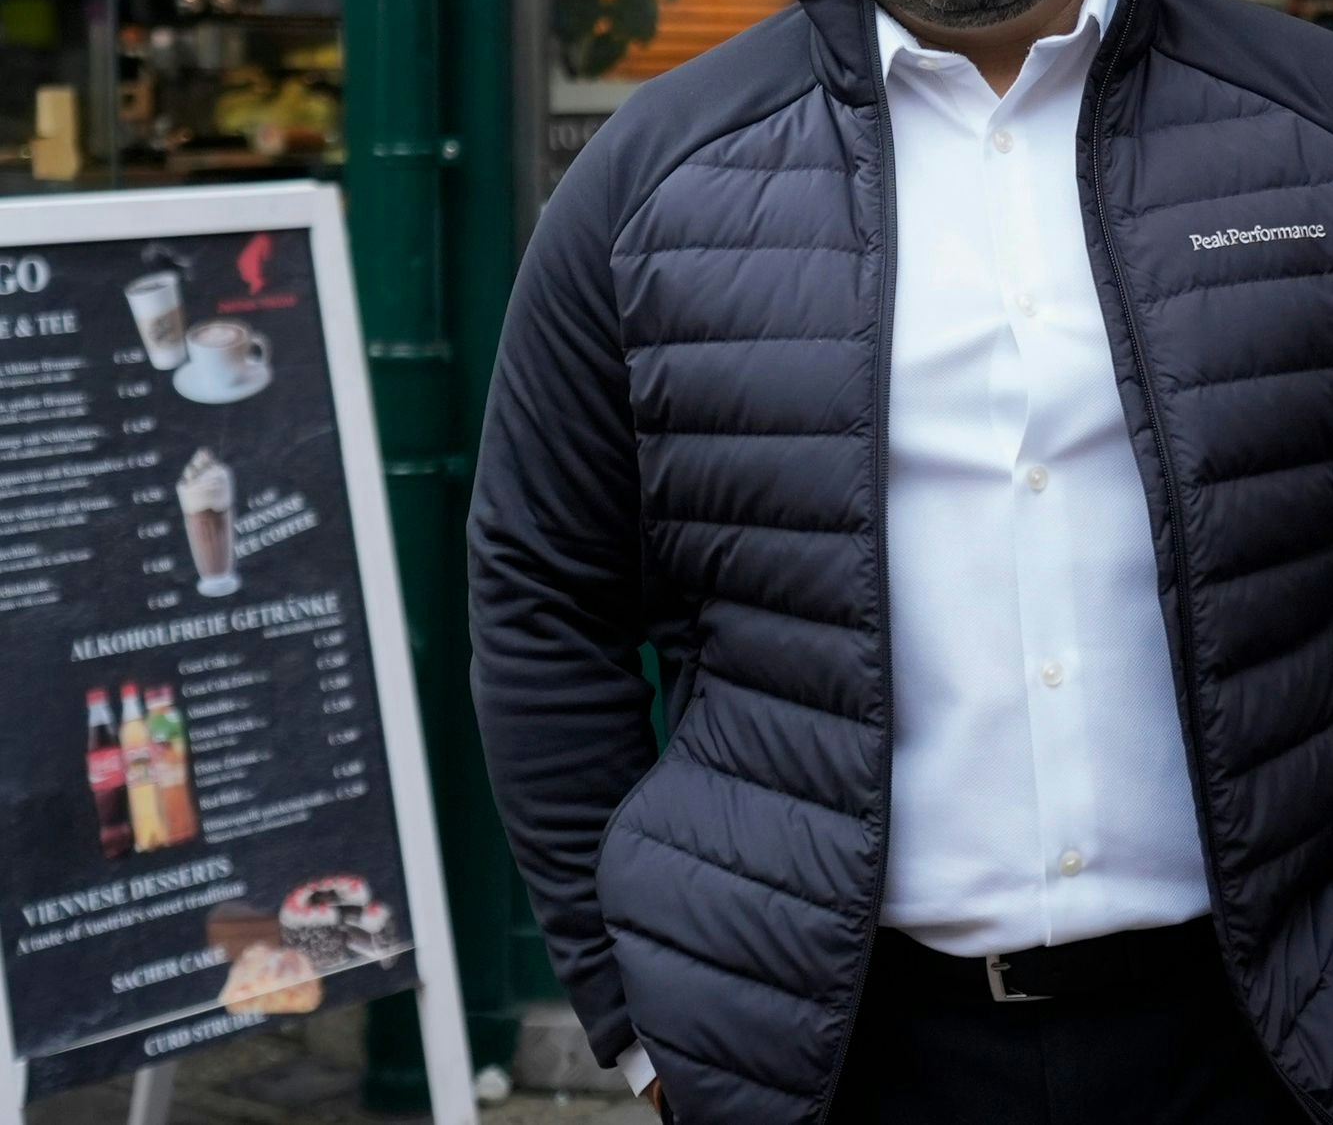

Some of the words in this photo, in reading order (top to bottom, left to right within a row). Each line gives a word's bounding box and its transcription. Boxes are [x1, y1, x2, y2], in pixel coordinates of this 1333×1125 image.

[36, 307, 79, 336] TEE
[233, 492, 304, 535] VIENNESE
[234, 535, 262, 559] ICE
[260, 509, 320, 546] COFFEE
[71, 612, 229, 662] ALKOHOLFREIE
[231, 592, 340, 632] GETRÄNKE
[23, 880, 128, 927] VIENNESE
[129, 855, 234, 899] DESSERTS
[31, 927, 65, 952] taste
[65, 921, 83, 943] of
[146, 895, 184, 920] sweet
[185, 879, 247, 905] tradition
[111, 955, 180, 994] SACHER
[179, 943, 230, 974] CAKE
[144, 1026, 193, 1057] CURD
